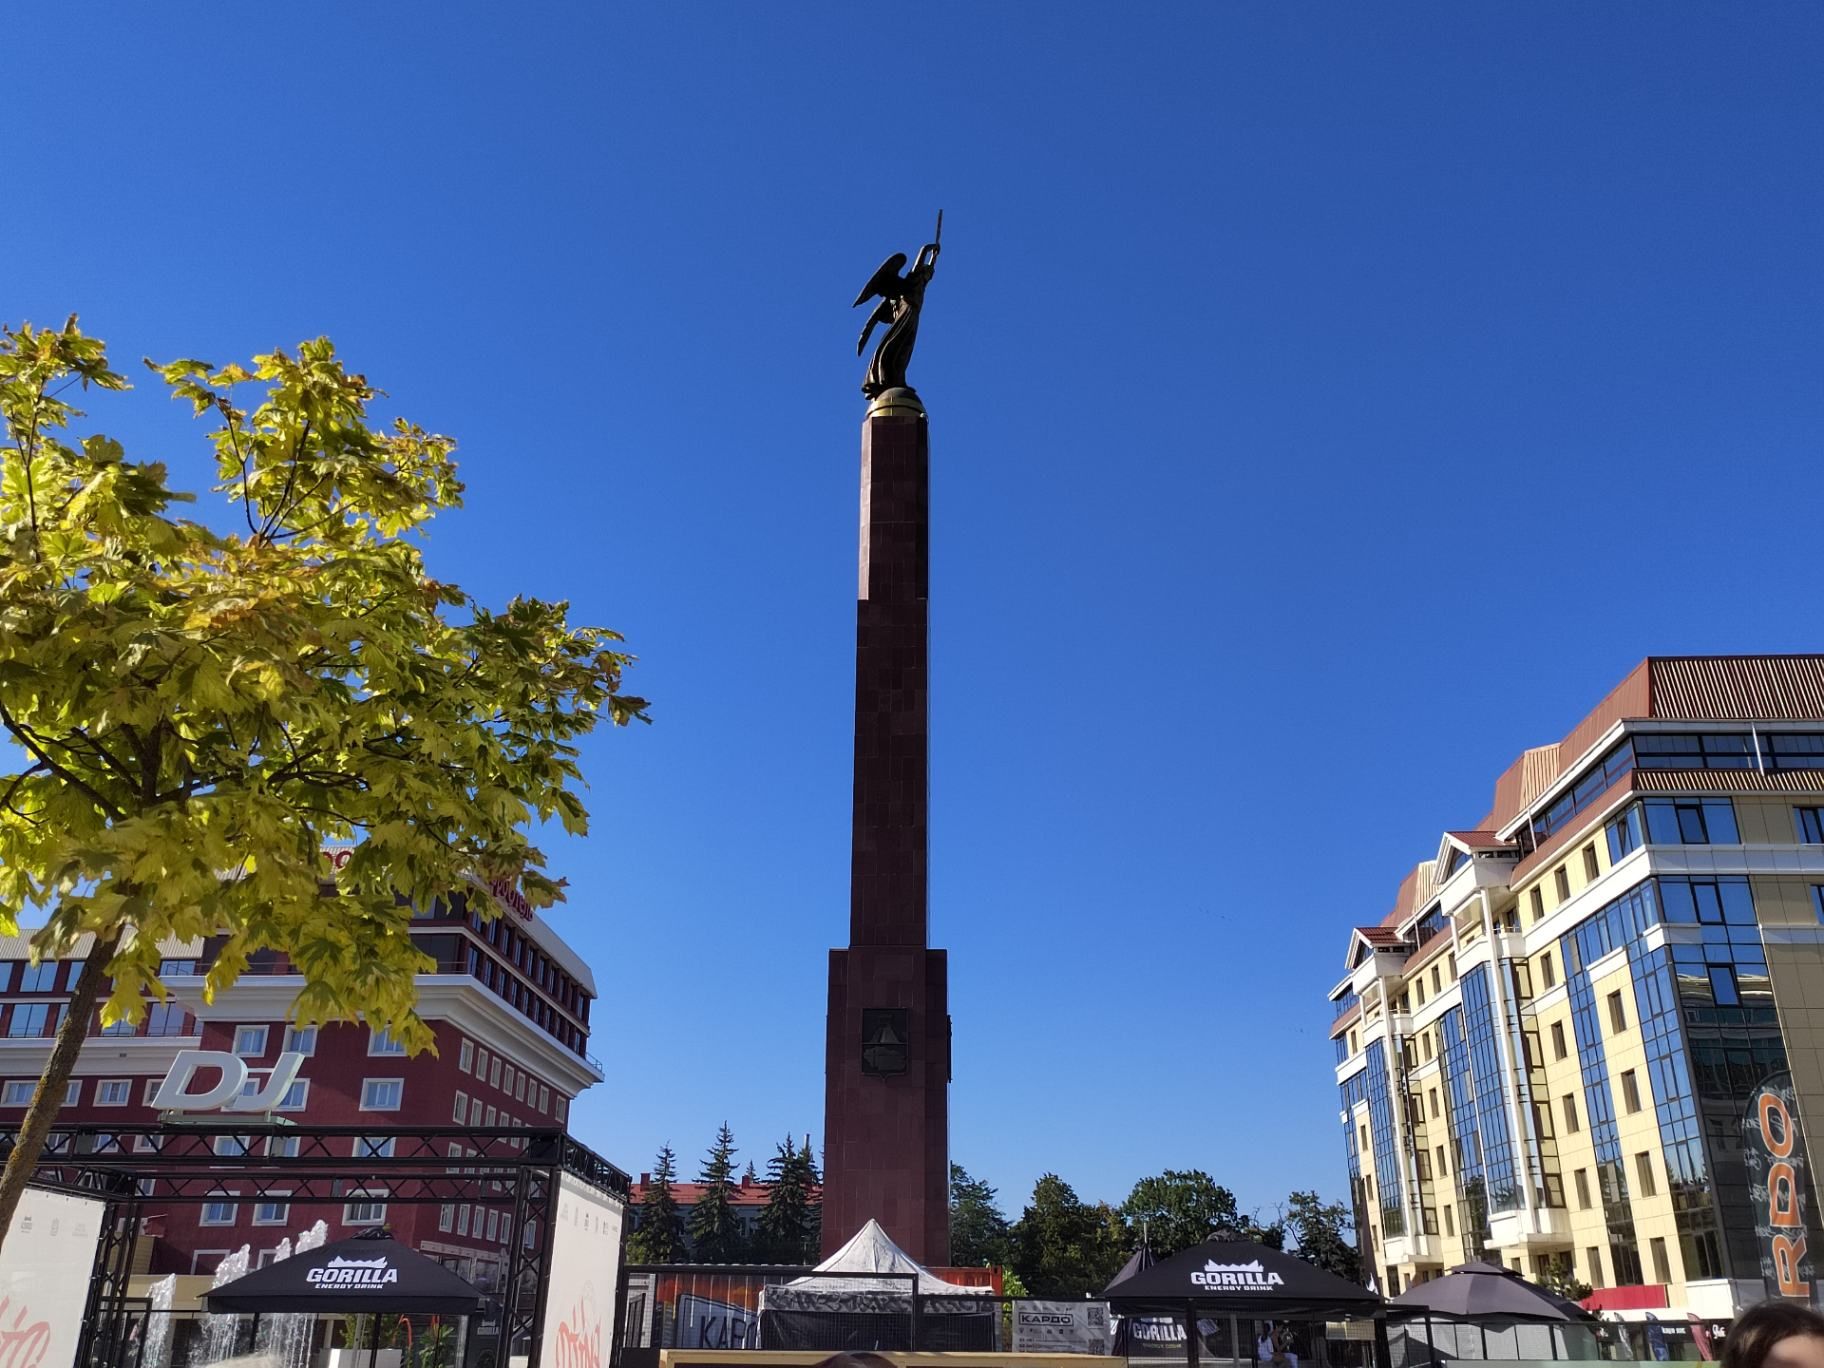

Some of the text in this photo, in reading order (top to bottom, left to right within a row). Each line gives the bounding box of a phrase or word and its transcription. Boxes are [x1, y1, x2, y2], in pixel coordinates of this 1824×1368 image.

[151, 1050, 305, 1111] DJ
[306, 1268, 397, 1283] GORILLA
[1190, 1271, 1284, 1285] GORILLA
[1021, 1314, 1071, 1324] КАРДО
[1132, 1322, 1187, 1341] GORILLA
